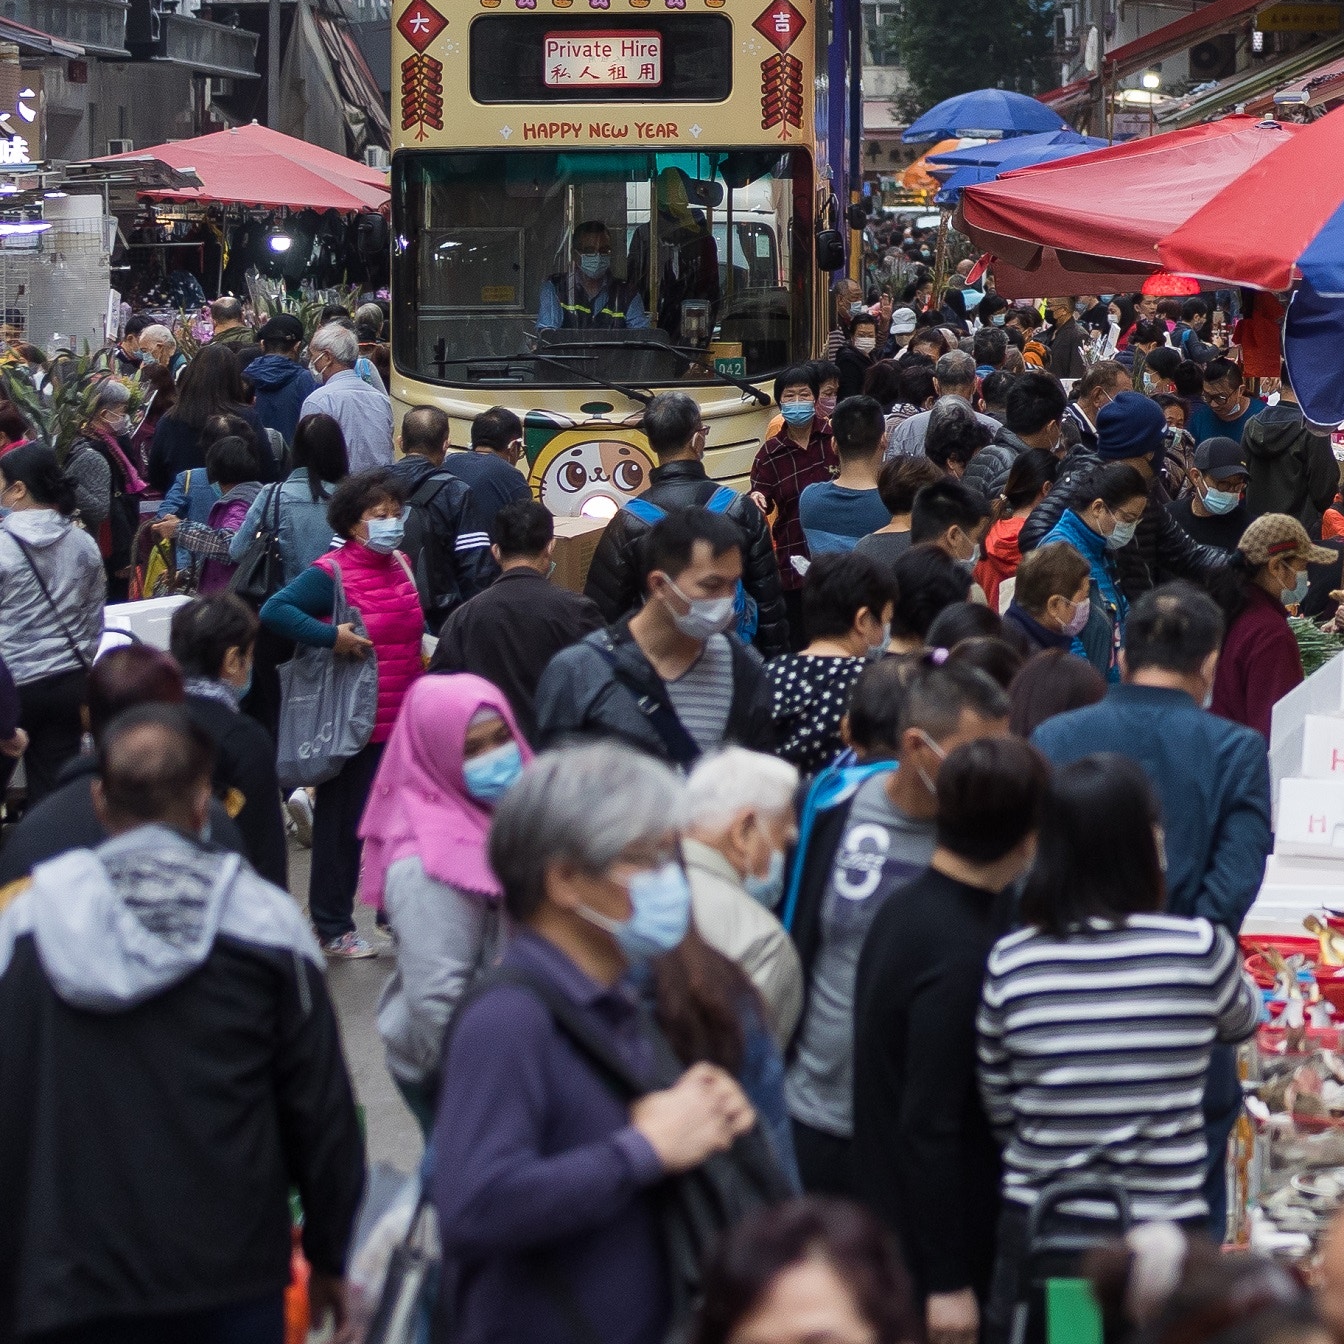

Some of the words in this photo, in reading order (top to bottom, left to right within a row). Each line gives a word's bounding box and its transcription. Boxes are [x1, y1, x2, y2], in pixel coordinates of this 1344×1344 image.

[410, 13, 430, 35] 大
[772, 13, 791, 33] 吉
[547, 41, 612, 58] Private
[621, 40, 658, 58] Hire
[549, 63, 656, 81] 私人租用
[523, 123, 582, 140] HAPPY
[588, 123, 628, 139] NEW
[633, 122, 680, 139] YEAR
[719, 363, 741, 375] 042
[1308, 814, 1326, 833] H
